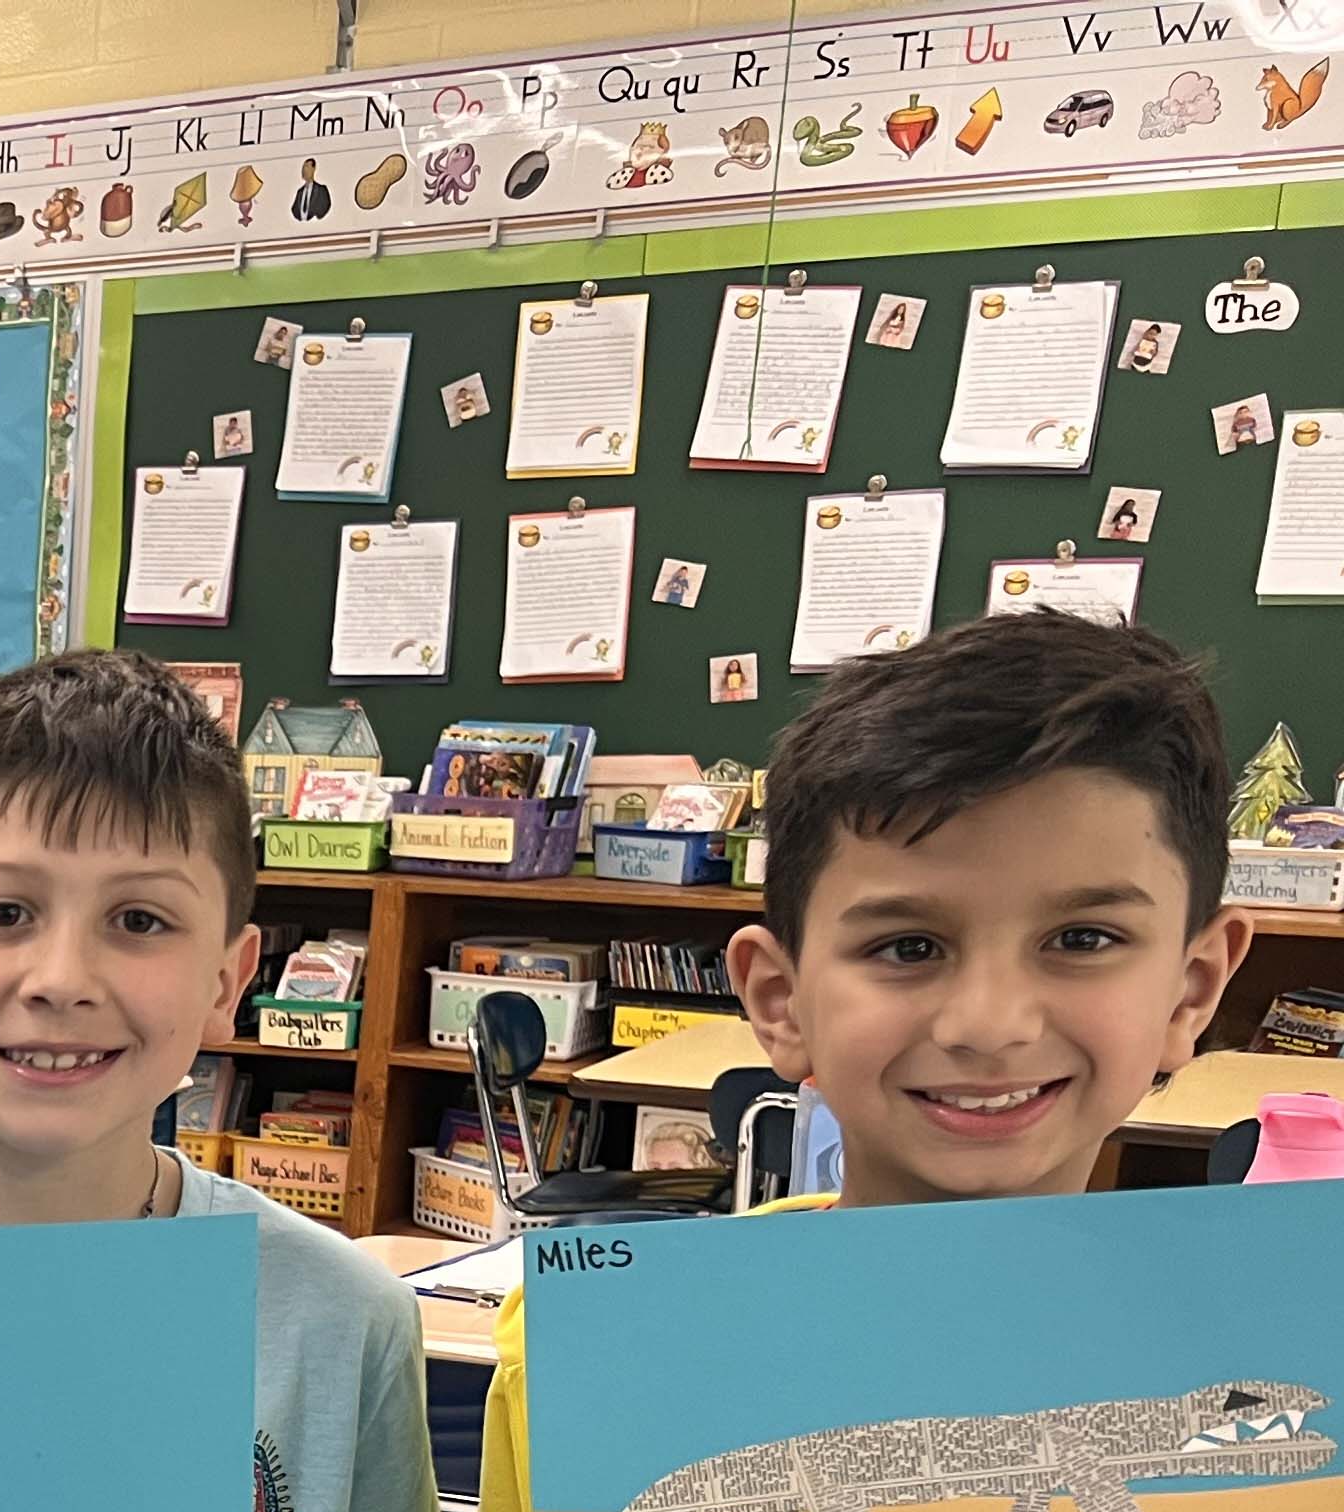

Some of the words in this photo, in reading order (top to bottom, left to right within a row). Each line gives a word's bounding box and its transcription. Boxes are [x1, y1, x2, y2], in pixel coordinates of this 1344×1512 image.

[45, 133, 73, 169] Ii
[106, 126, 133, 177] Jj
[177, 118, 209, 155] Kk
[240, 110, 263, 145] Ll
[291, 103, 344, 141] Mm
[365, 94, 407, 133] Nn
[433, 86, 484, 121] Oo
[521, 75, 559, 130] Pp
[599, 66, 650, 104] Qu
[663, 69, 702, 113] qu
[733, 51, 769, 90] Rr
[814, 40, 850, 81] Ss
[893, 31, 934, 71] Tt
[966, 25, 1010, 66] Uu
[1063, 14, 1114, 55] Vv
[1154, 3, 1232, 46] Ww
[1214, 293, 1282, 325] The
[267, 832, 300, 858] Owl
[400, 822, 448, 847] Animal
[459, 825, 509, 850] Fiction
[608, 836, 670, 862] Riverside
[621, 858, 652, 877] Kids
[1225, 879, 1298, 904] Academy
[287, 1031, 322, 1047] Club
[280, 1158, 316, 1182] School
[319, 1161, 340, 1185] Bus
[457, 1186, 485, 1212] Books
[536, 1236, 633, 1275] Miles
